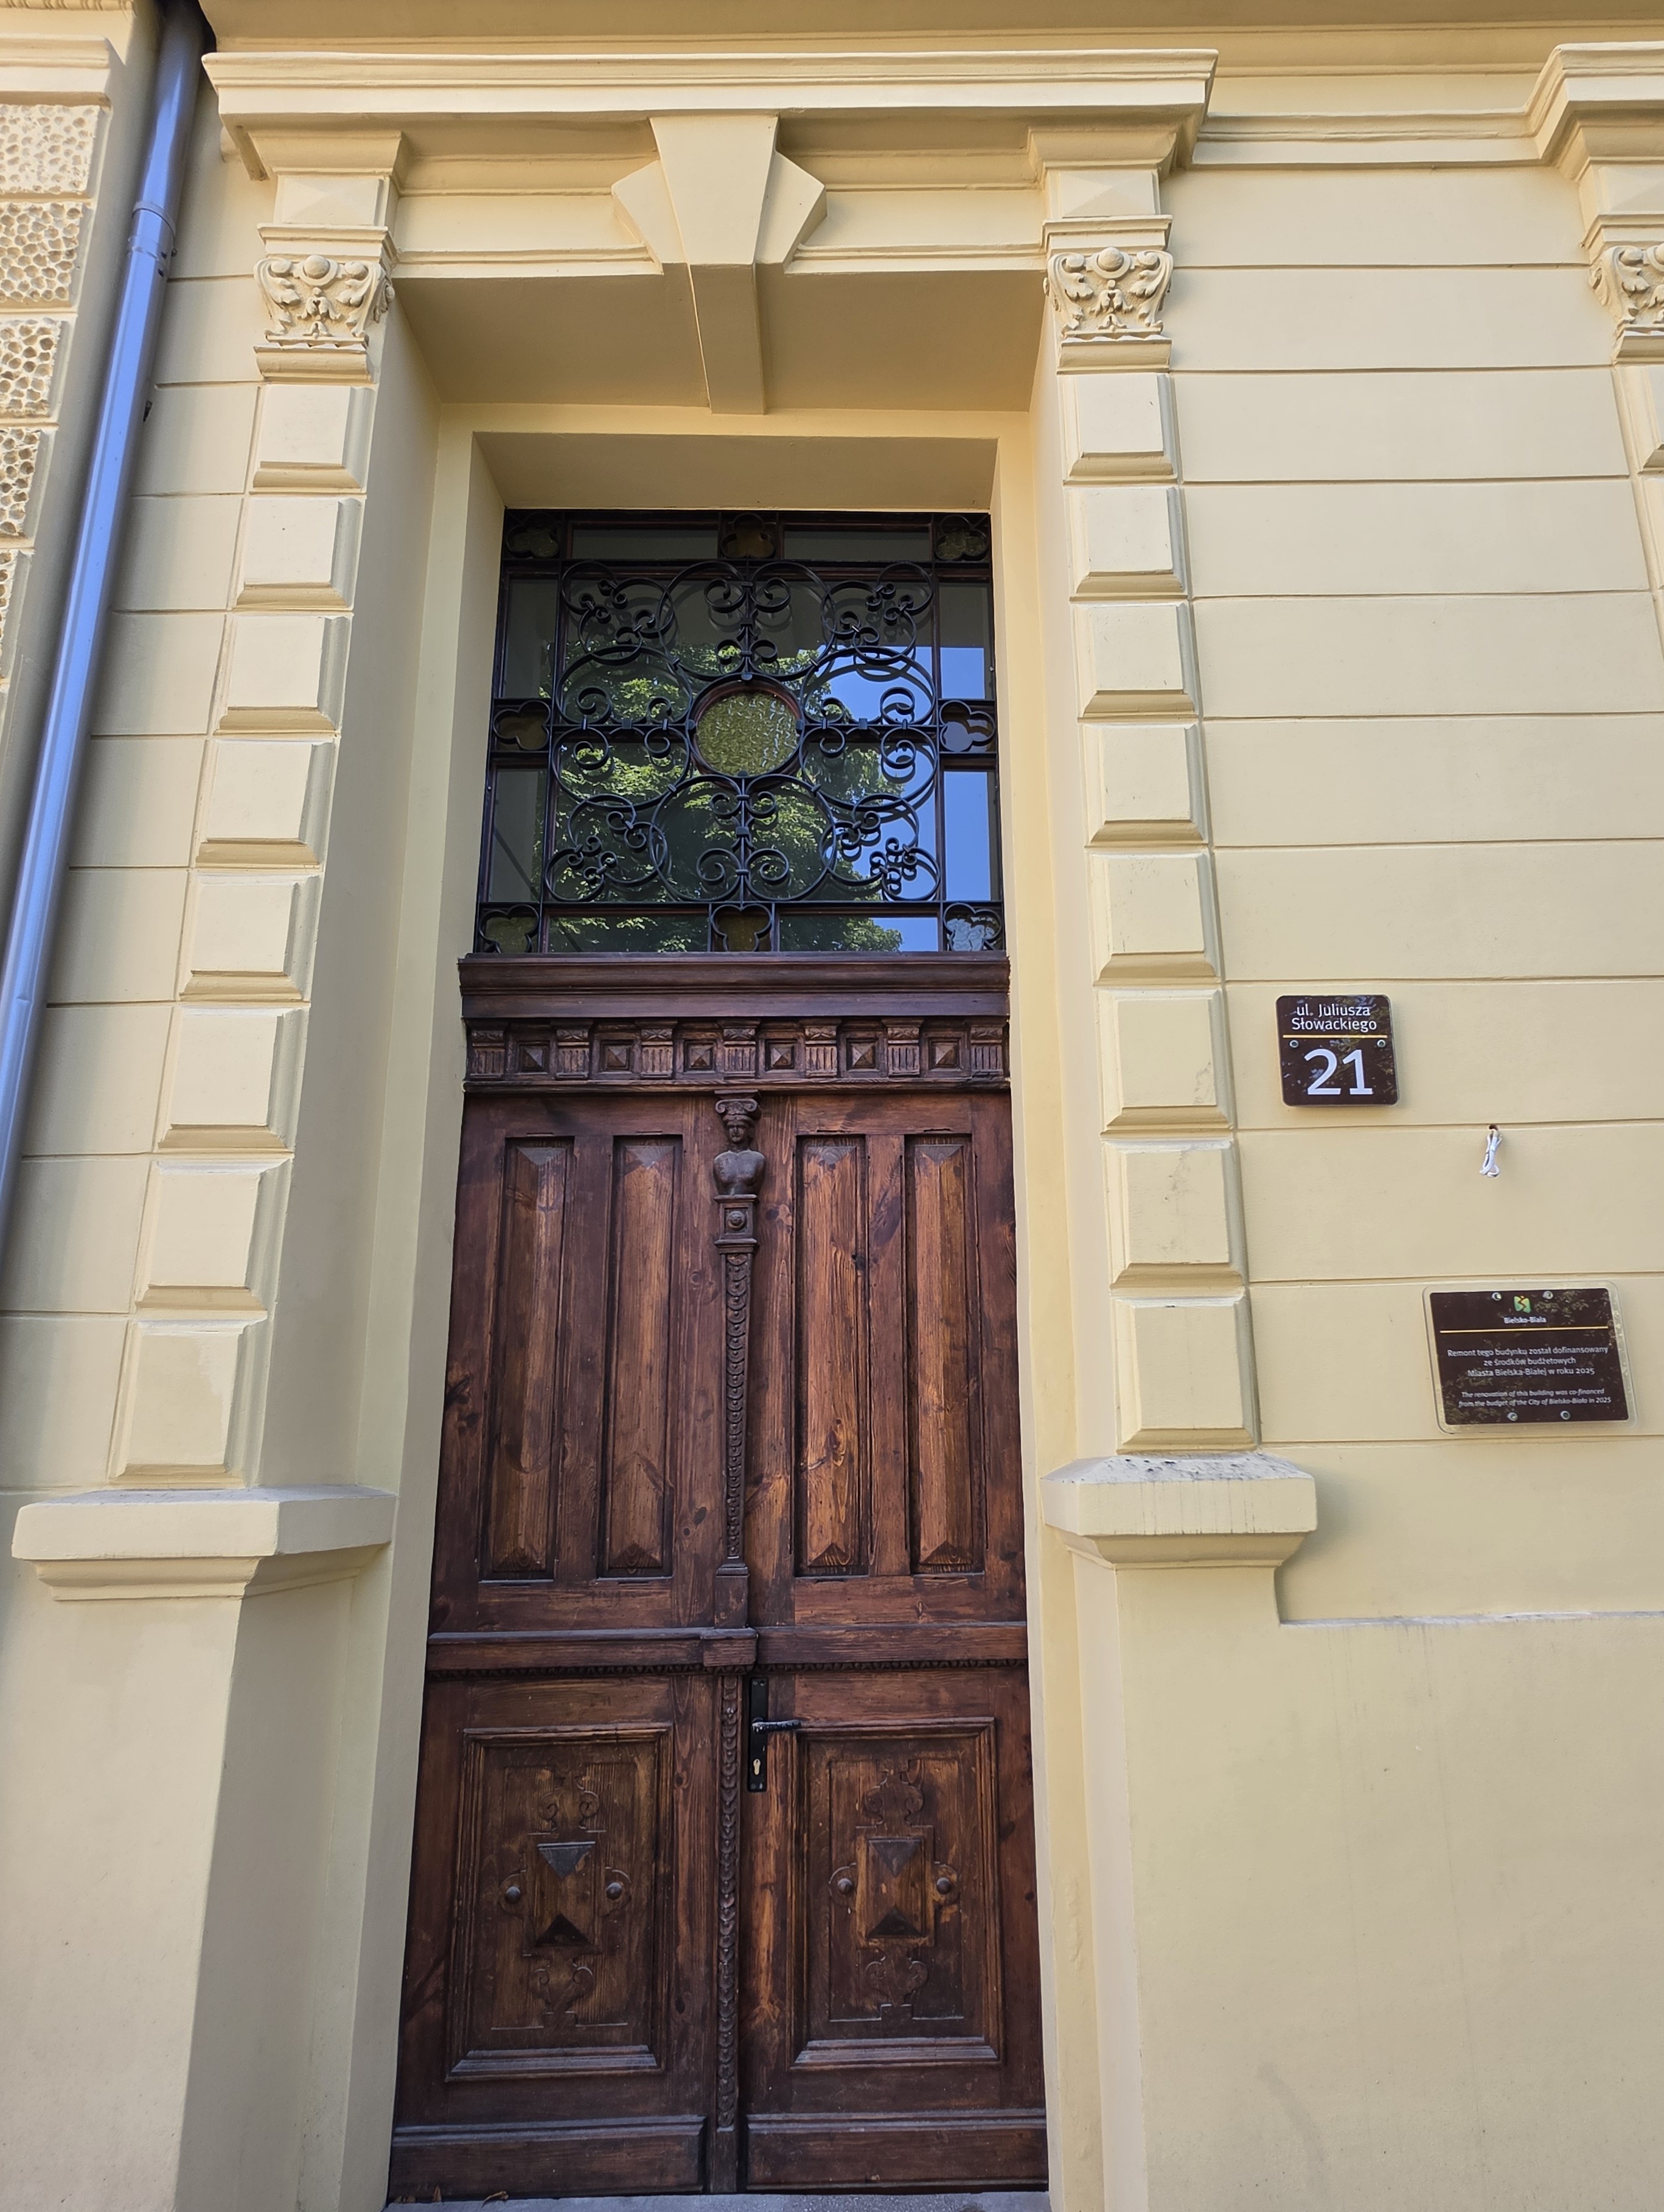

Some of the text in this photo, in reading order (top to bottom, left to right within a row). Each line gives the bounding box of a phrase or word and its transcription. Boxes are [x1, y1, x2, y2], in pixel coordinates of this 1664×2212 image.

[1297, 1003, 1370, 1017] ul. Juliusza
[1292, 1017, 1377, 1033] Słowackiego
[1304, 1048, 1373, 1095] 21
[1494, 1348, 1527, 1356] budynku
[1527, 1356, 1576, 1365] budżetowych
